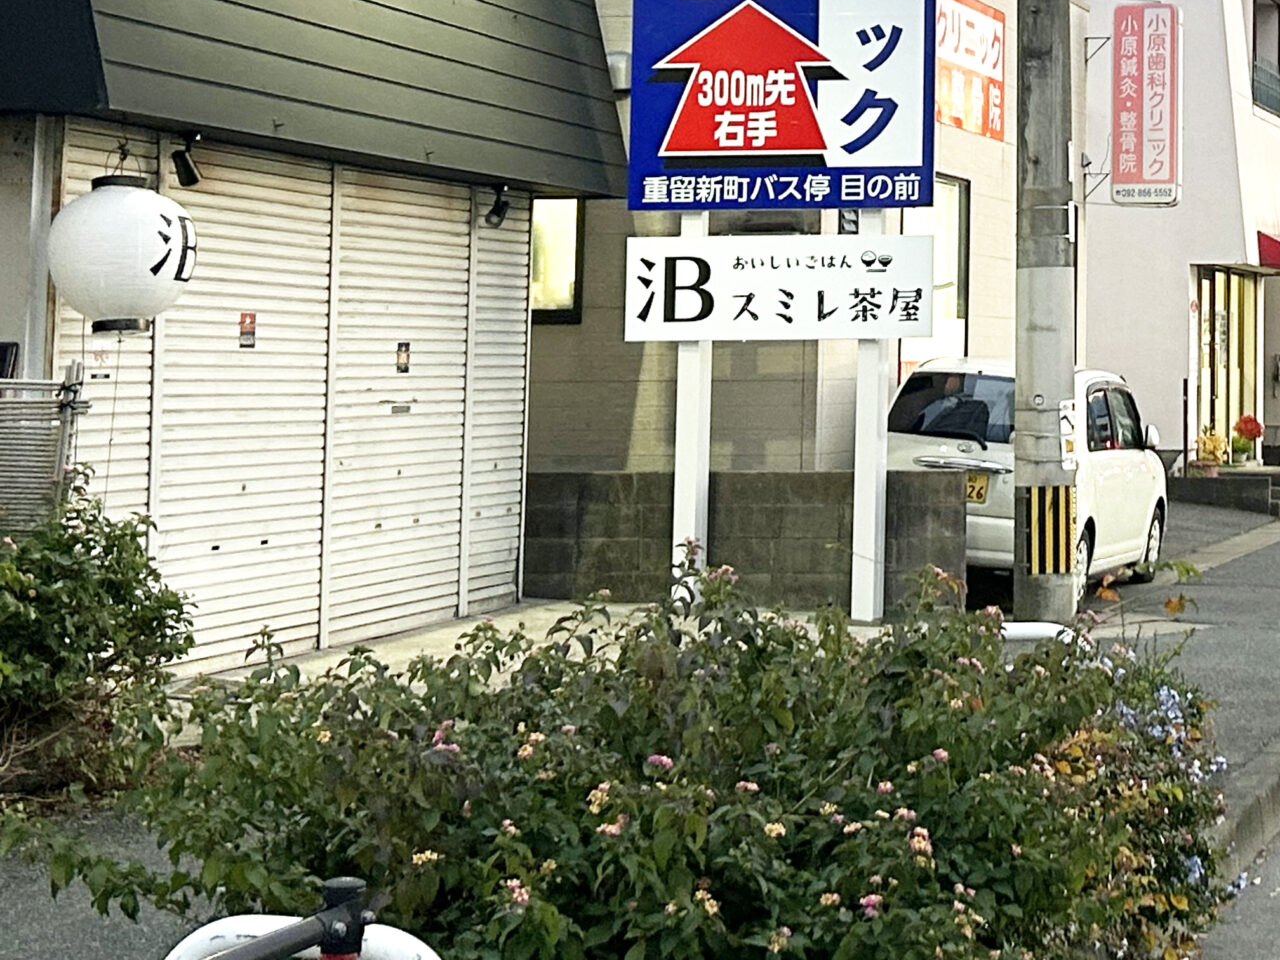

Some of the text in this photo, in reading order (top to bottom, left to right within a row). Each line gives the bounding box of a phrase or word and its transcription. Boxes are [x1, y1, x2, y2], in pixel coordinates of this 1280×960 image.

[698, 70, 795, 107] 300m先
[1147, 13, 1167, 177] 小原歯科クリニック
[714, 111, 777, 147] 右手
[841, 172, 921, 202] 目の前
[732, 254, 852, 270] おいしいごはん
[733, 287, 923, 324] スミレ茶屋
